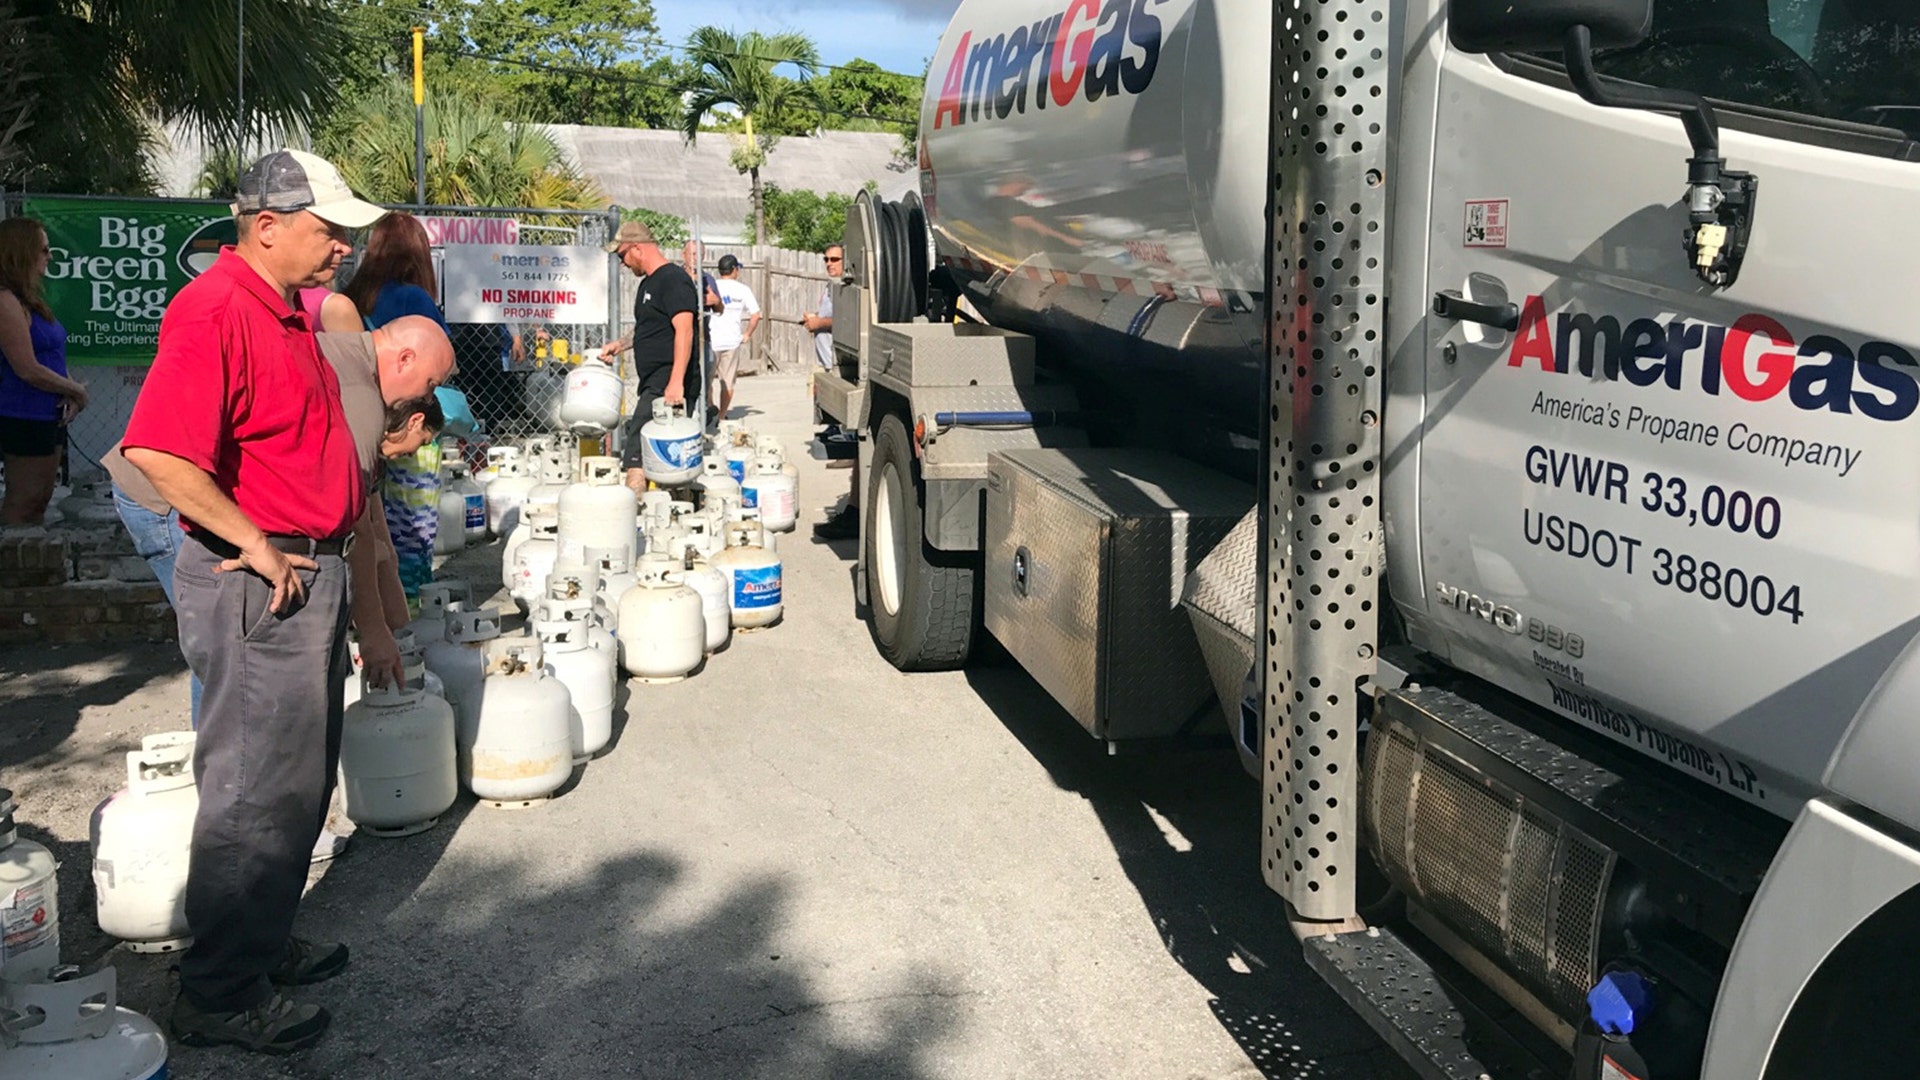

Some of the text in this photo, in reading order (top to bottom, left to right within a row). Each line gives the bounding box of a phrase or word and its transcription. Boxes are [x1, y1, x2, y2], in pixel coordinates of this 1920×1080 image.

[934, 0, 1171, 129] AmeriGas
[100, 216, 166, 256] Big
[427, 217, 517, 245] SMOKING
[45, 247, 168, 281] Green
[502, 271, 519, 280] 561
[524, 272, 542, 280] 844
[90, 281, 166, 319] Egg
[482, 288, 577, 304] NO SMOKING
[503, 307, 555, 318] PROPANE
[66, 333, 160, 346] king Experienc
[84, 320, 161, 332] The Ultimat
[1507, 294, 1919, 421] AmeriGas
[1531, 390, 1862, 477] America's Propane Company
[1525, 445, 1781, 540] GVWR 33,000
[1523, 508, 1804, 624] USDOT 388004
[1436, 581, 1523, 635] HINO
[1627, 713, 1722, 784] Propane,
